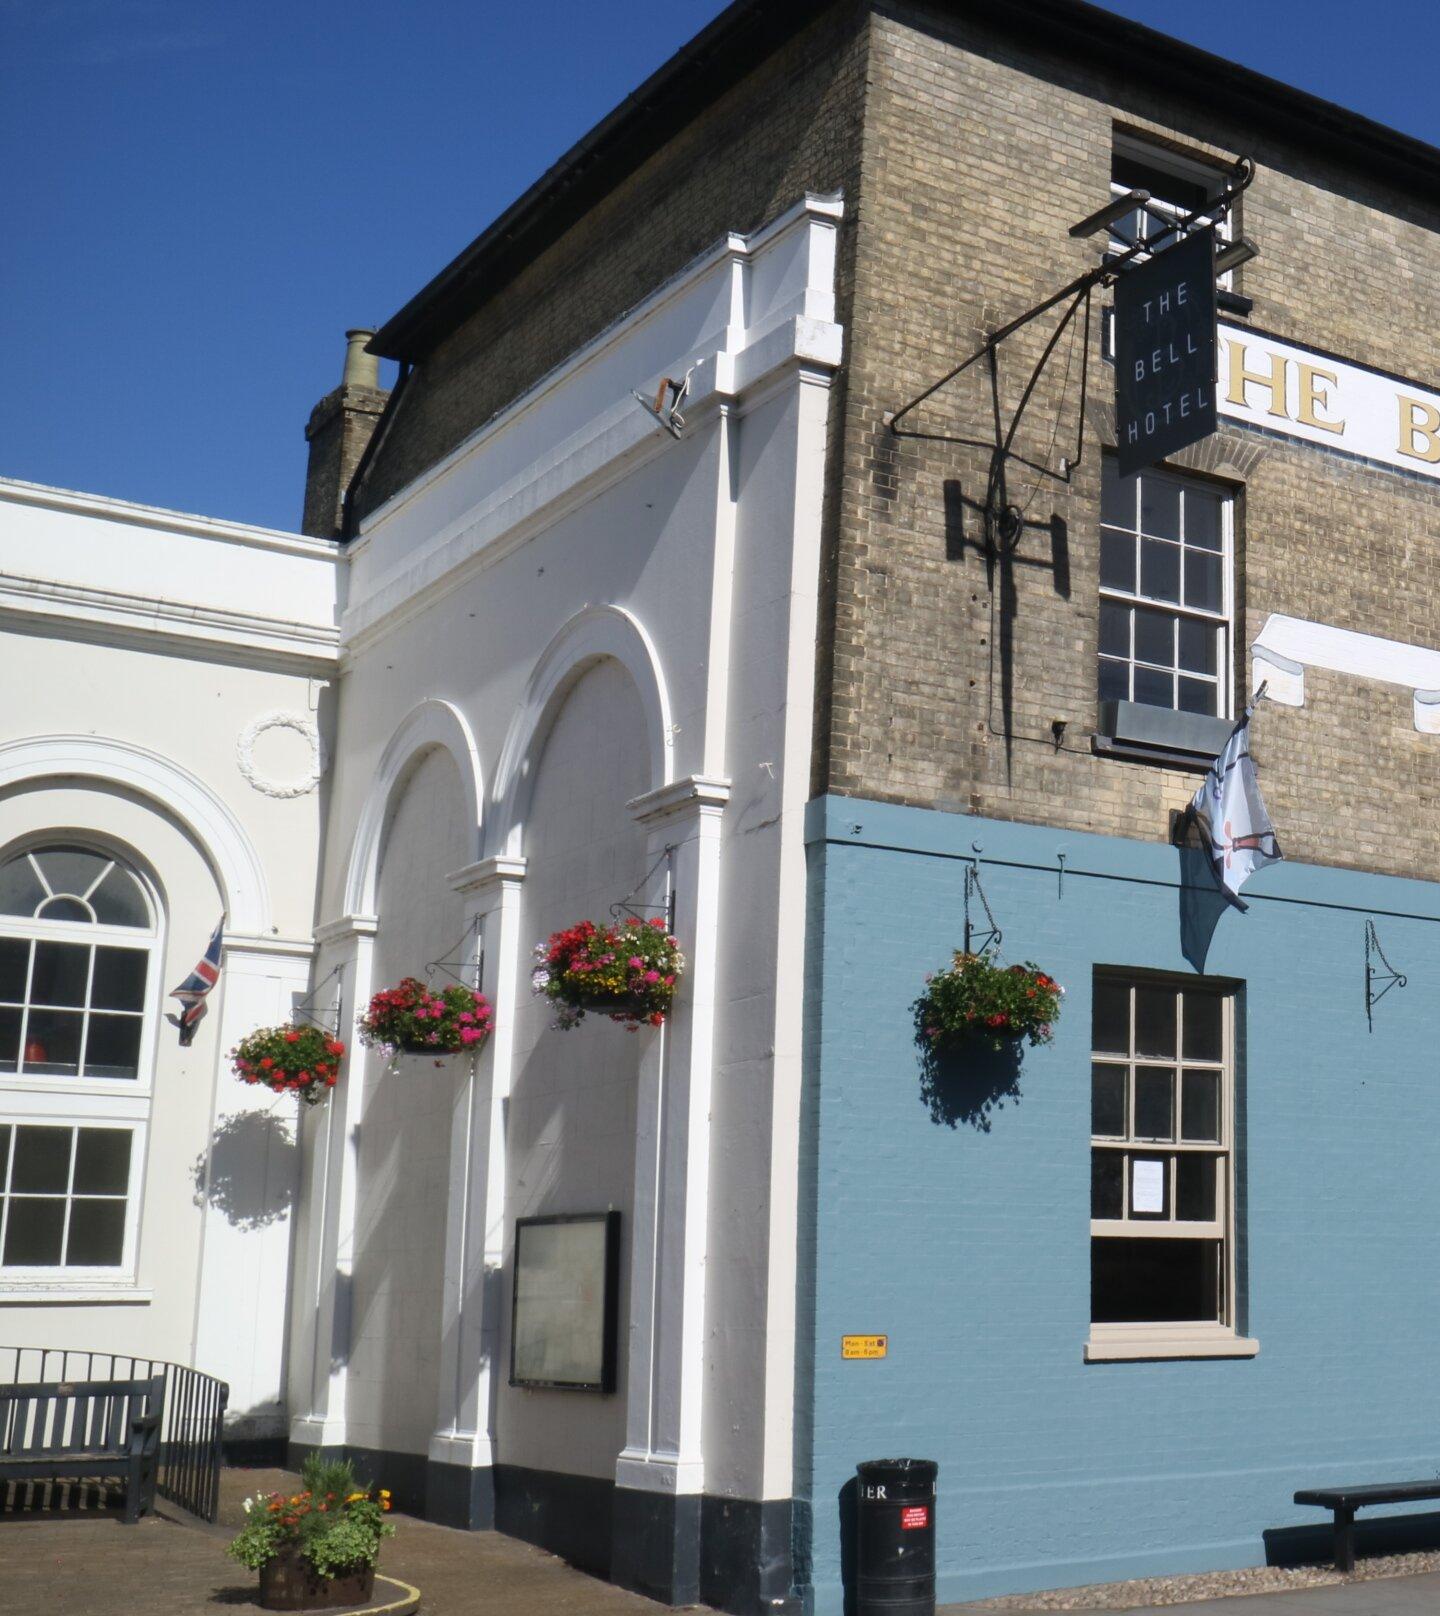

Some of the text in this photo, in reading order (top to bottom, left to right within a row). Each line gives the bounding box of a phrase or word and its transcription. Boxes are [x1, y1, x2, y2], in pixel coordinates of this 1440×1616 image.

[1143, 281, 1187, 323] THE
[1135, 333, 1198, 382] BELL
[1217, 336, 1346, 436] HE
[1128, 387, 1209, 445] HOTEL
